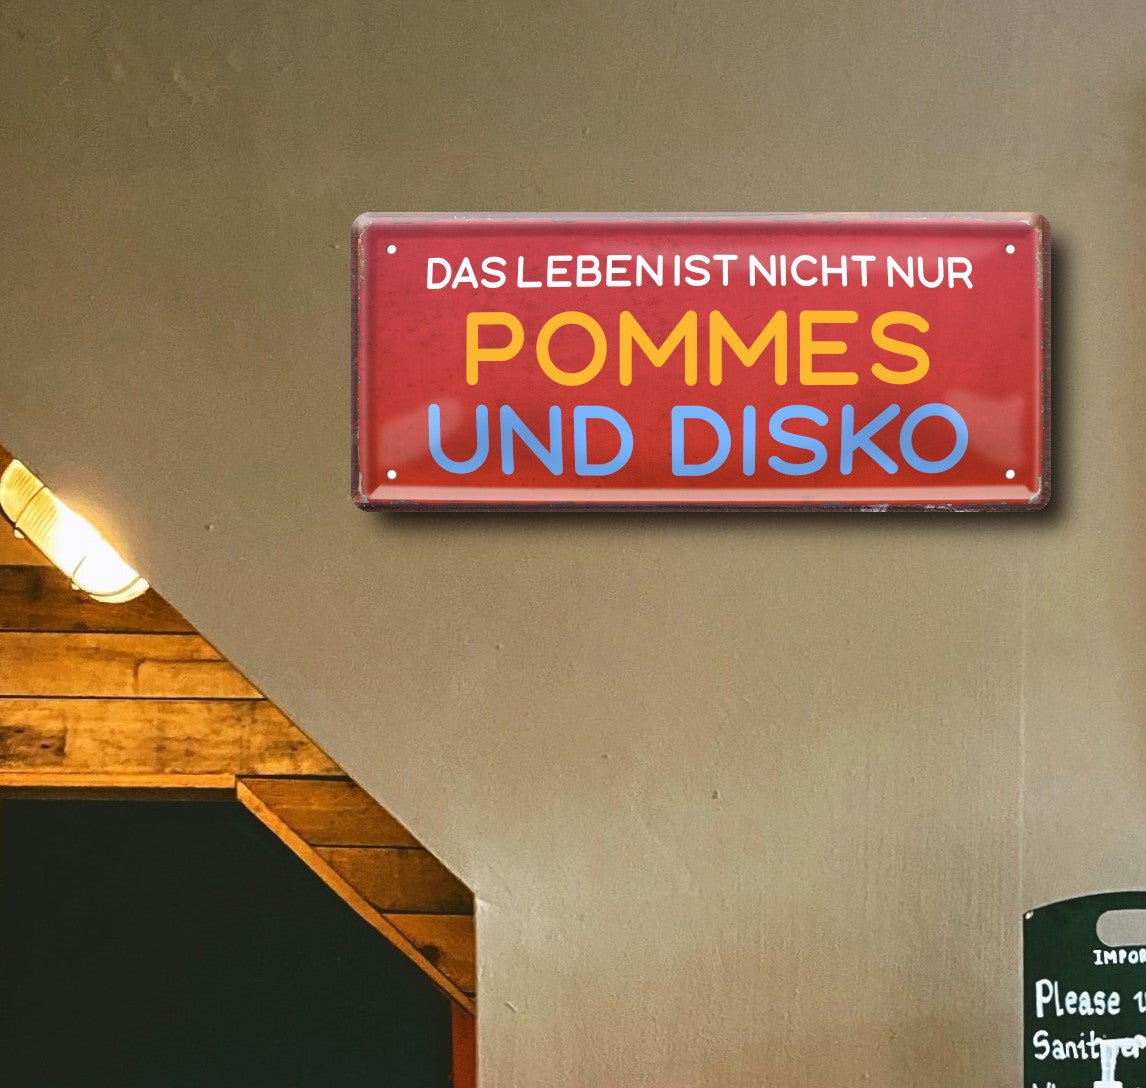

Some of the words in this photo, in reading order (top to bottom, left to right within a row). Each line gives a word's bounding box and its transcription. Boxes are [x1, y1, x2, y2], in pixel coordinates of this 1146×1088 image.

[426, 255, 507, 290] DAS
[516, 254, 663, 288] LEBEN
[673, 254, 739, 287] IST
[749, 254, 877, 288] NICHT
[886, 255, 974, 289] NUR
[465, 309, 931, 387] POMMES
[427, 403, 635, 477] UND
[671, 403, 970, 477] DISKO
[1035, 978, 1121, 1018] Please
